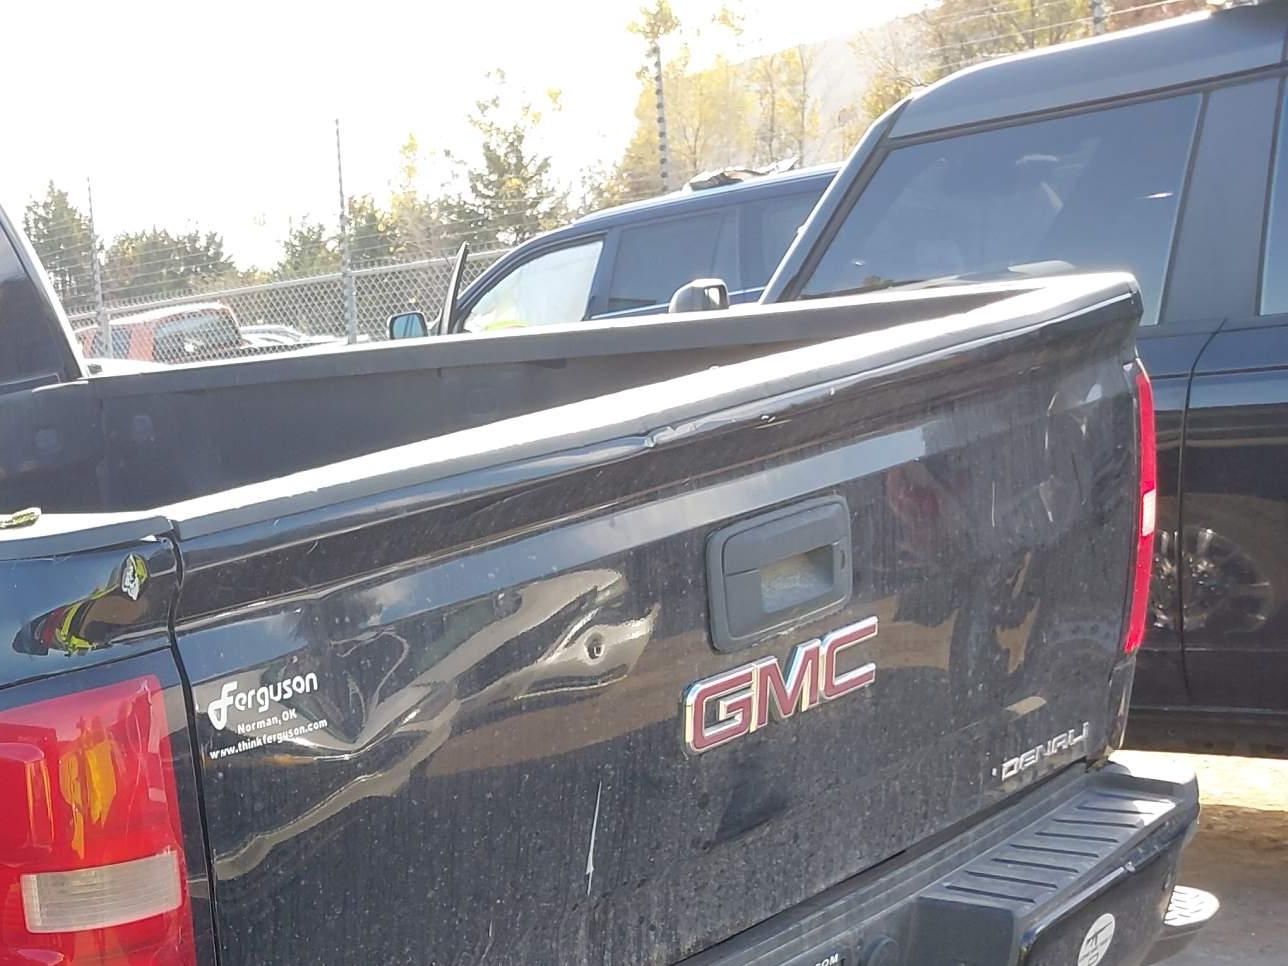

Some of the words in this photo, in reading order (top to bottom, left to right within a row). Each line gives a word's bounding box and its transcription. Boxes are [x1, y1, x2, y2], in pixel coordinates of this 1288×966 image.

[207, 672, 318, 731] Ferguson
[282, 707, 298, 722] OK
[682, 616, 879, 755] GMC
[209, 718, 328, 760] www.thinkferguson.com
[1001, 721, 1090, 781] DENALI
